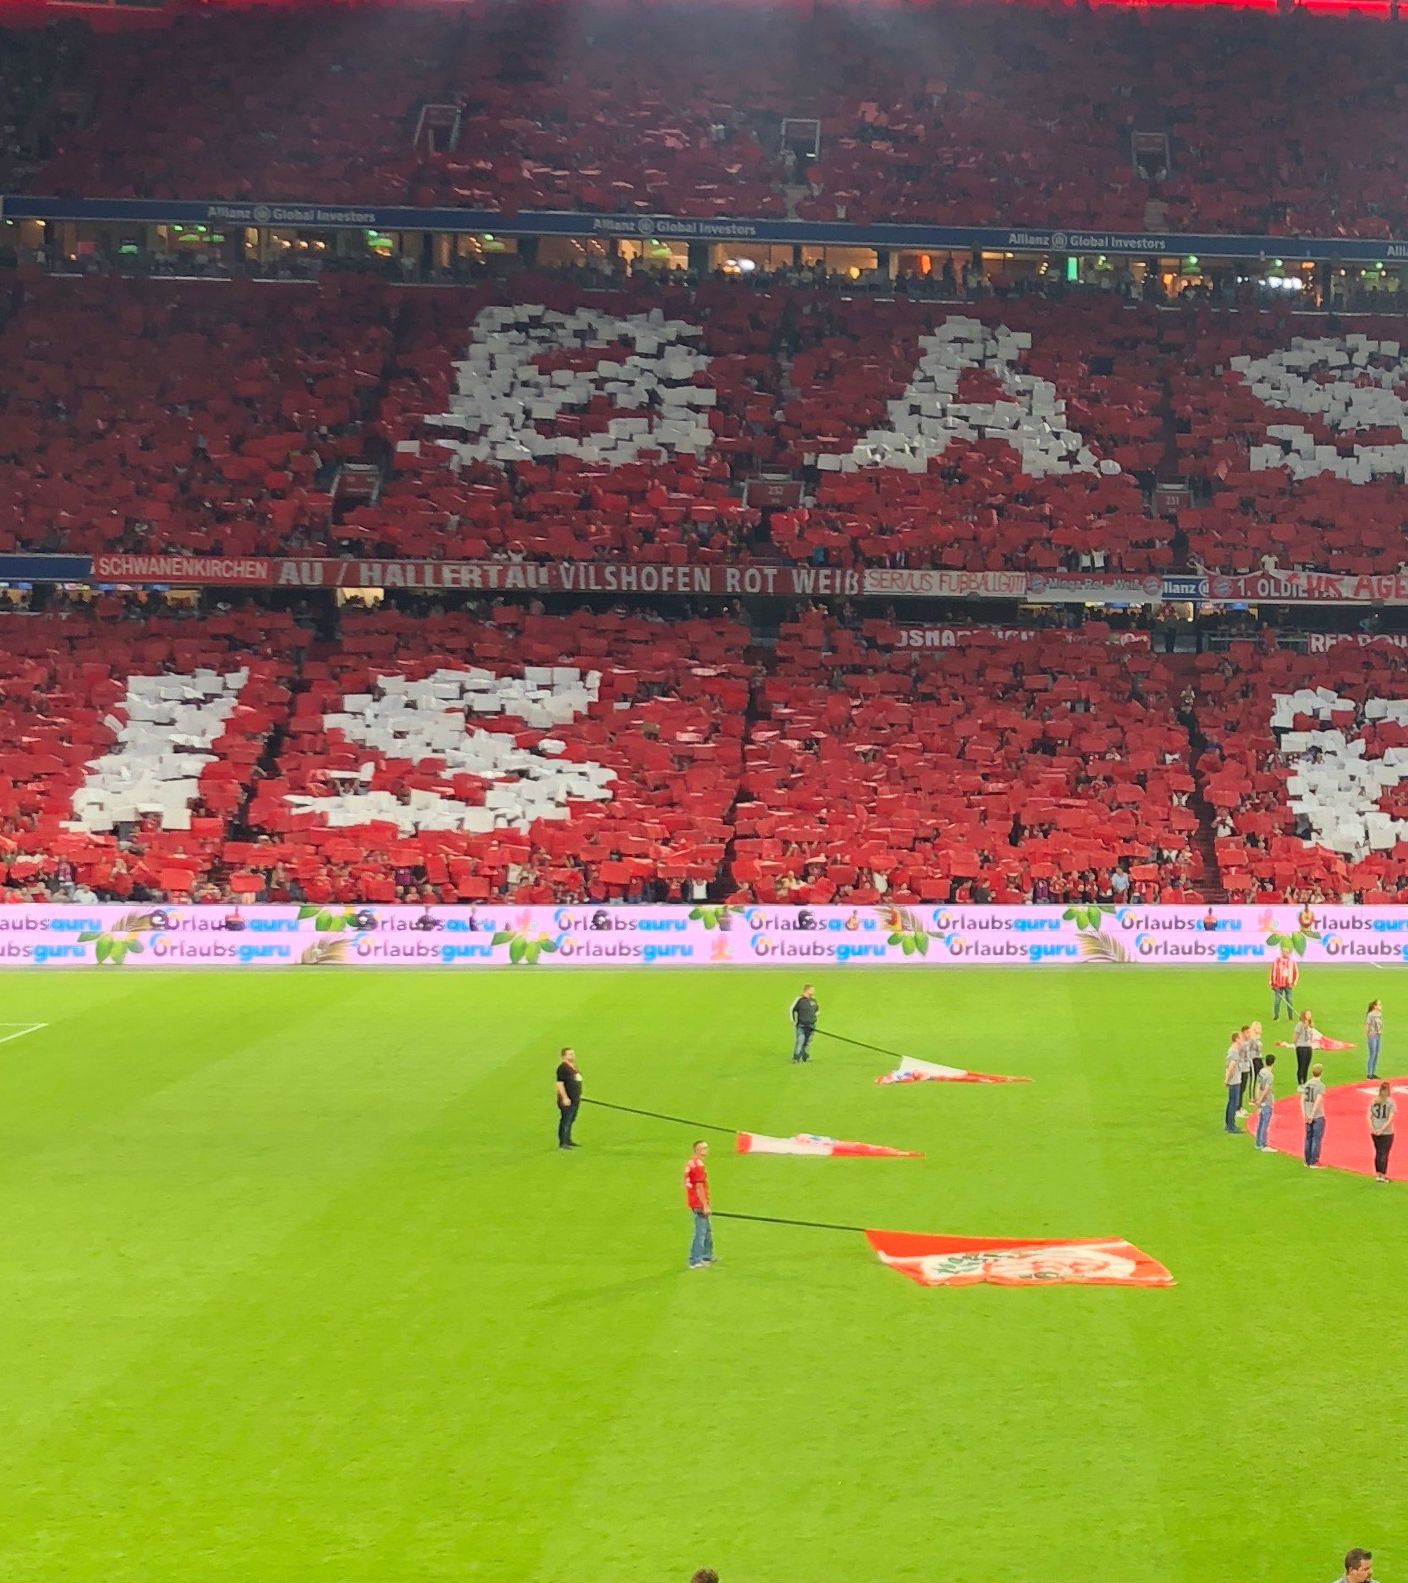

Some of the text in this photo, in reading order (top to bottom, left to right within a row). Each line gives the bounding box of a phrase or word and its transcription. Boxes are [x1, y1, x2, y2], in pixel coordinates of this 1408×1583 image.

[207, 206, 376, 223] Allianz Global Investors
[593, 218, 756, 236] Allianz Global Investors
[1008, 233, 1166, 249] Allianz Global Investors
[99, 558, 269, 579] SCHWANENKIRCHEN
[278, 562, 323, 586] AU
[359, 563, 550, 588] HALLERTAU
[558, 564, 711, 592] VILSHOFEN
[726, 568, 778, 593] ROT
[869, 571, 933, 592] SERVUS
[1163, 582, 1197, 594] lianz
[59, 666, 618, 835] IS
[936, 914, 1061, 931] Urlaubsguru
[153, 939, 291, 961] Urlaubsguru
[357, 939, 493, 961] Urlaubsguru
[559, 939, 694, 961] Urlaubsguru
[754, 939, 886, 961] Urlaubsguru
[949, 939, 1079, 961] Urlaubsguru
[1138, 939, 1265, 961] Urlaubsguru
[1372, 1103, 1388, 1119] 31
